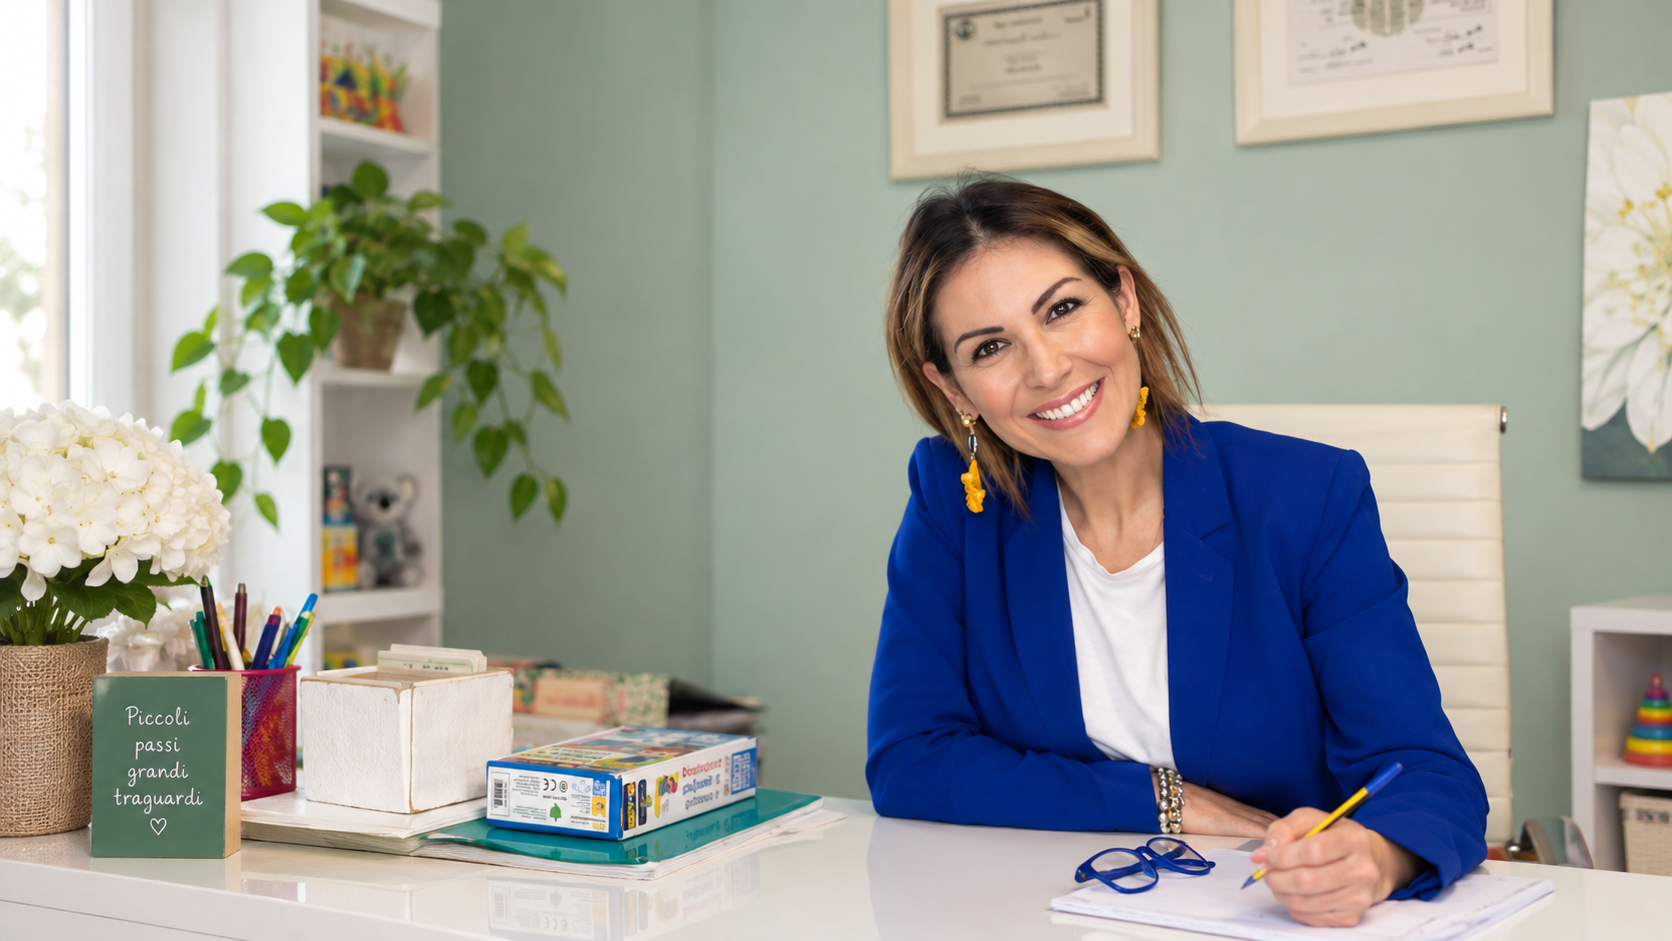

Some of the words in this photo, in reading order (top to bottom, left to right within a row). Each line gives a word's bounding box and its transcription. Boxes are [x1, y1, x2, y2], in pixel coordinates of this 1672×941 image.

[125, 705, 190, 726] Piccoli
[135, 737, 181, 760] passi
[127, 761, 189, 787] grandi
[113, 787, 204, 815] traguardi
